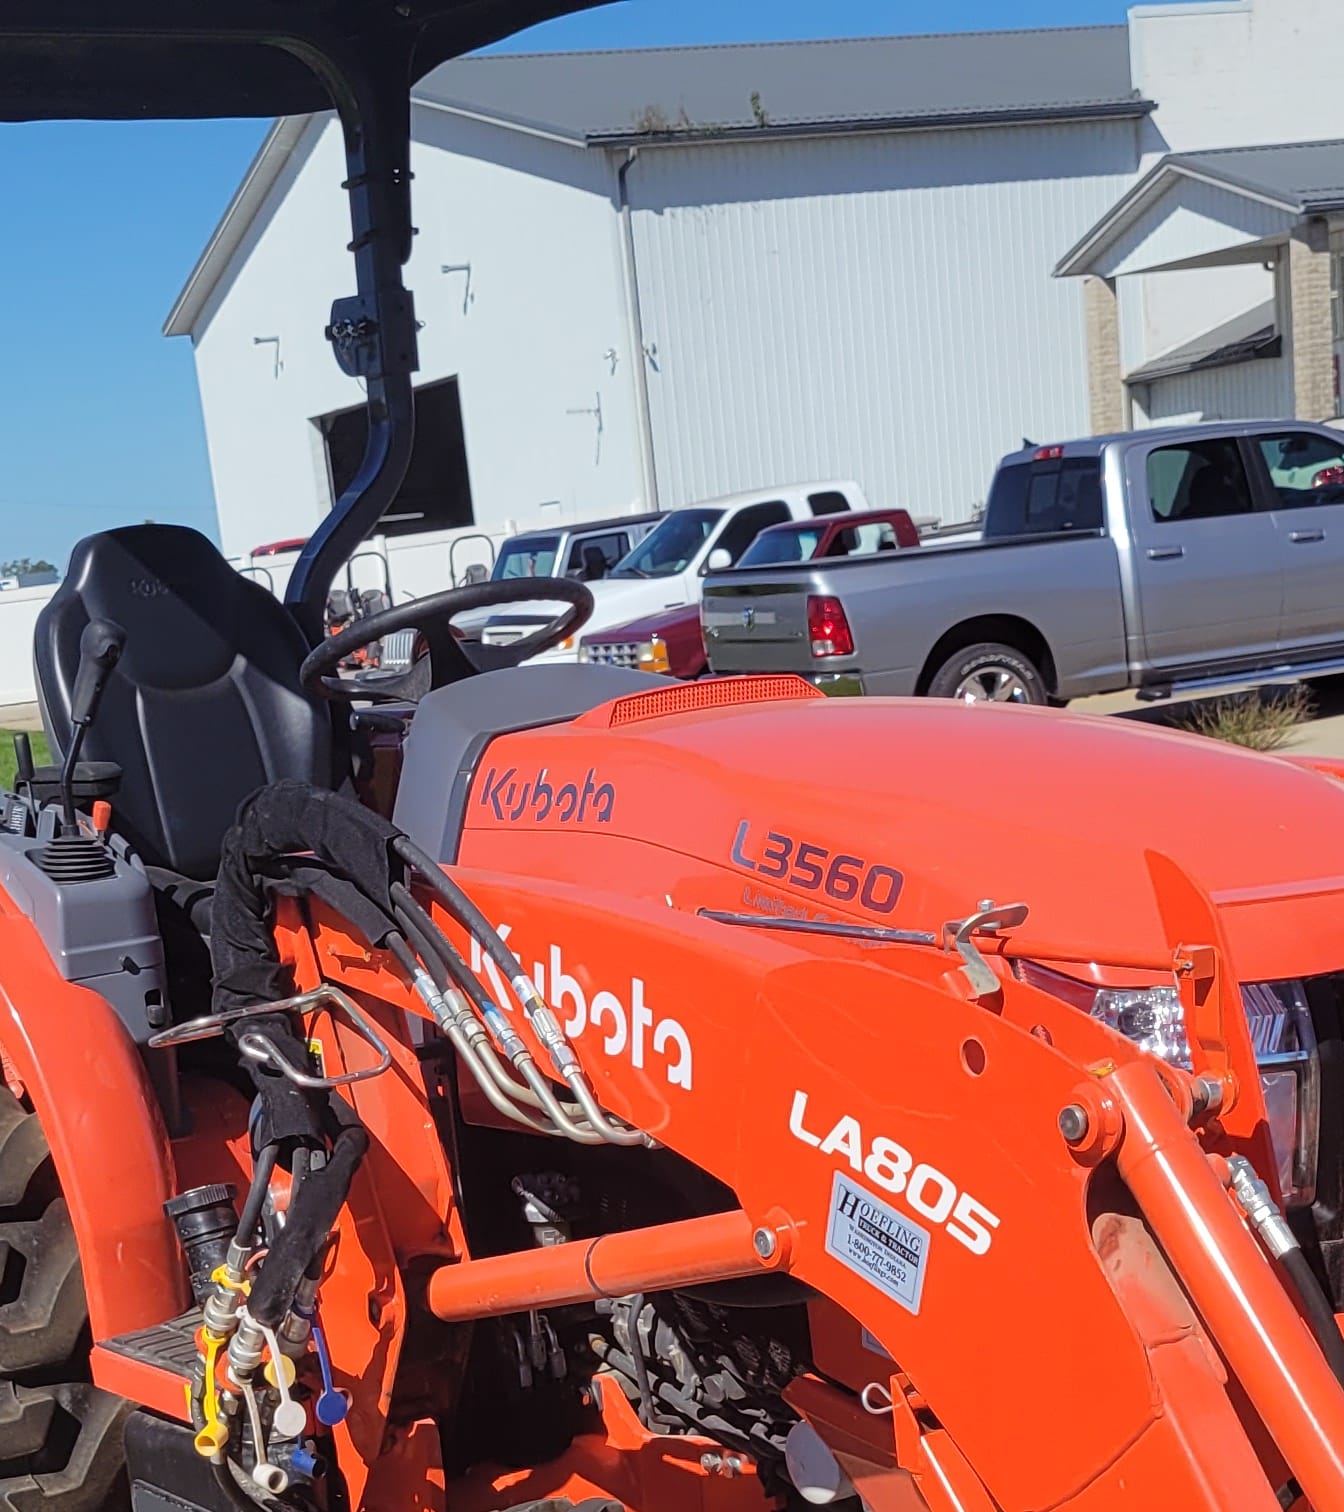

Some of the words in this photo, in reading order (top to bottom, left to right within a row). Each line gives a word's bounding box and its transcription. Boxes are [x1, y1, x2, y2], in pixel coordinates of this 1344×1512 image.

[480, 766, 615, 823] Kubota
[730, 818, 905, 915] L3560
[743, 886, 809, 921] Limited
[789, 1089, 1001, 1256] LA805
[837, 1185, 922, 1252] HOEFLING
[859, 1219, 881, 1240] TRUCK
[888, 1239, 919, 1267] TRACTOR
[847, 1233, 907, 1283] 1-800-777-9852
